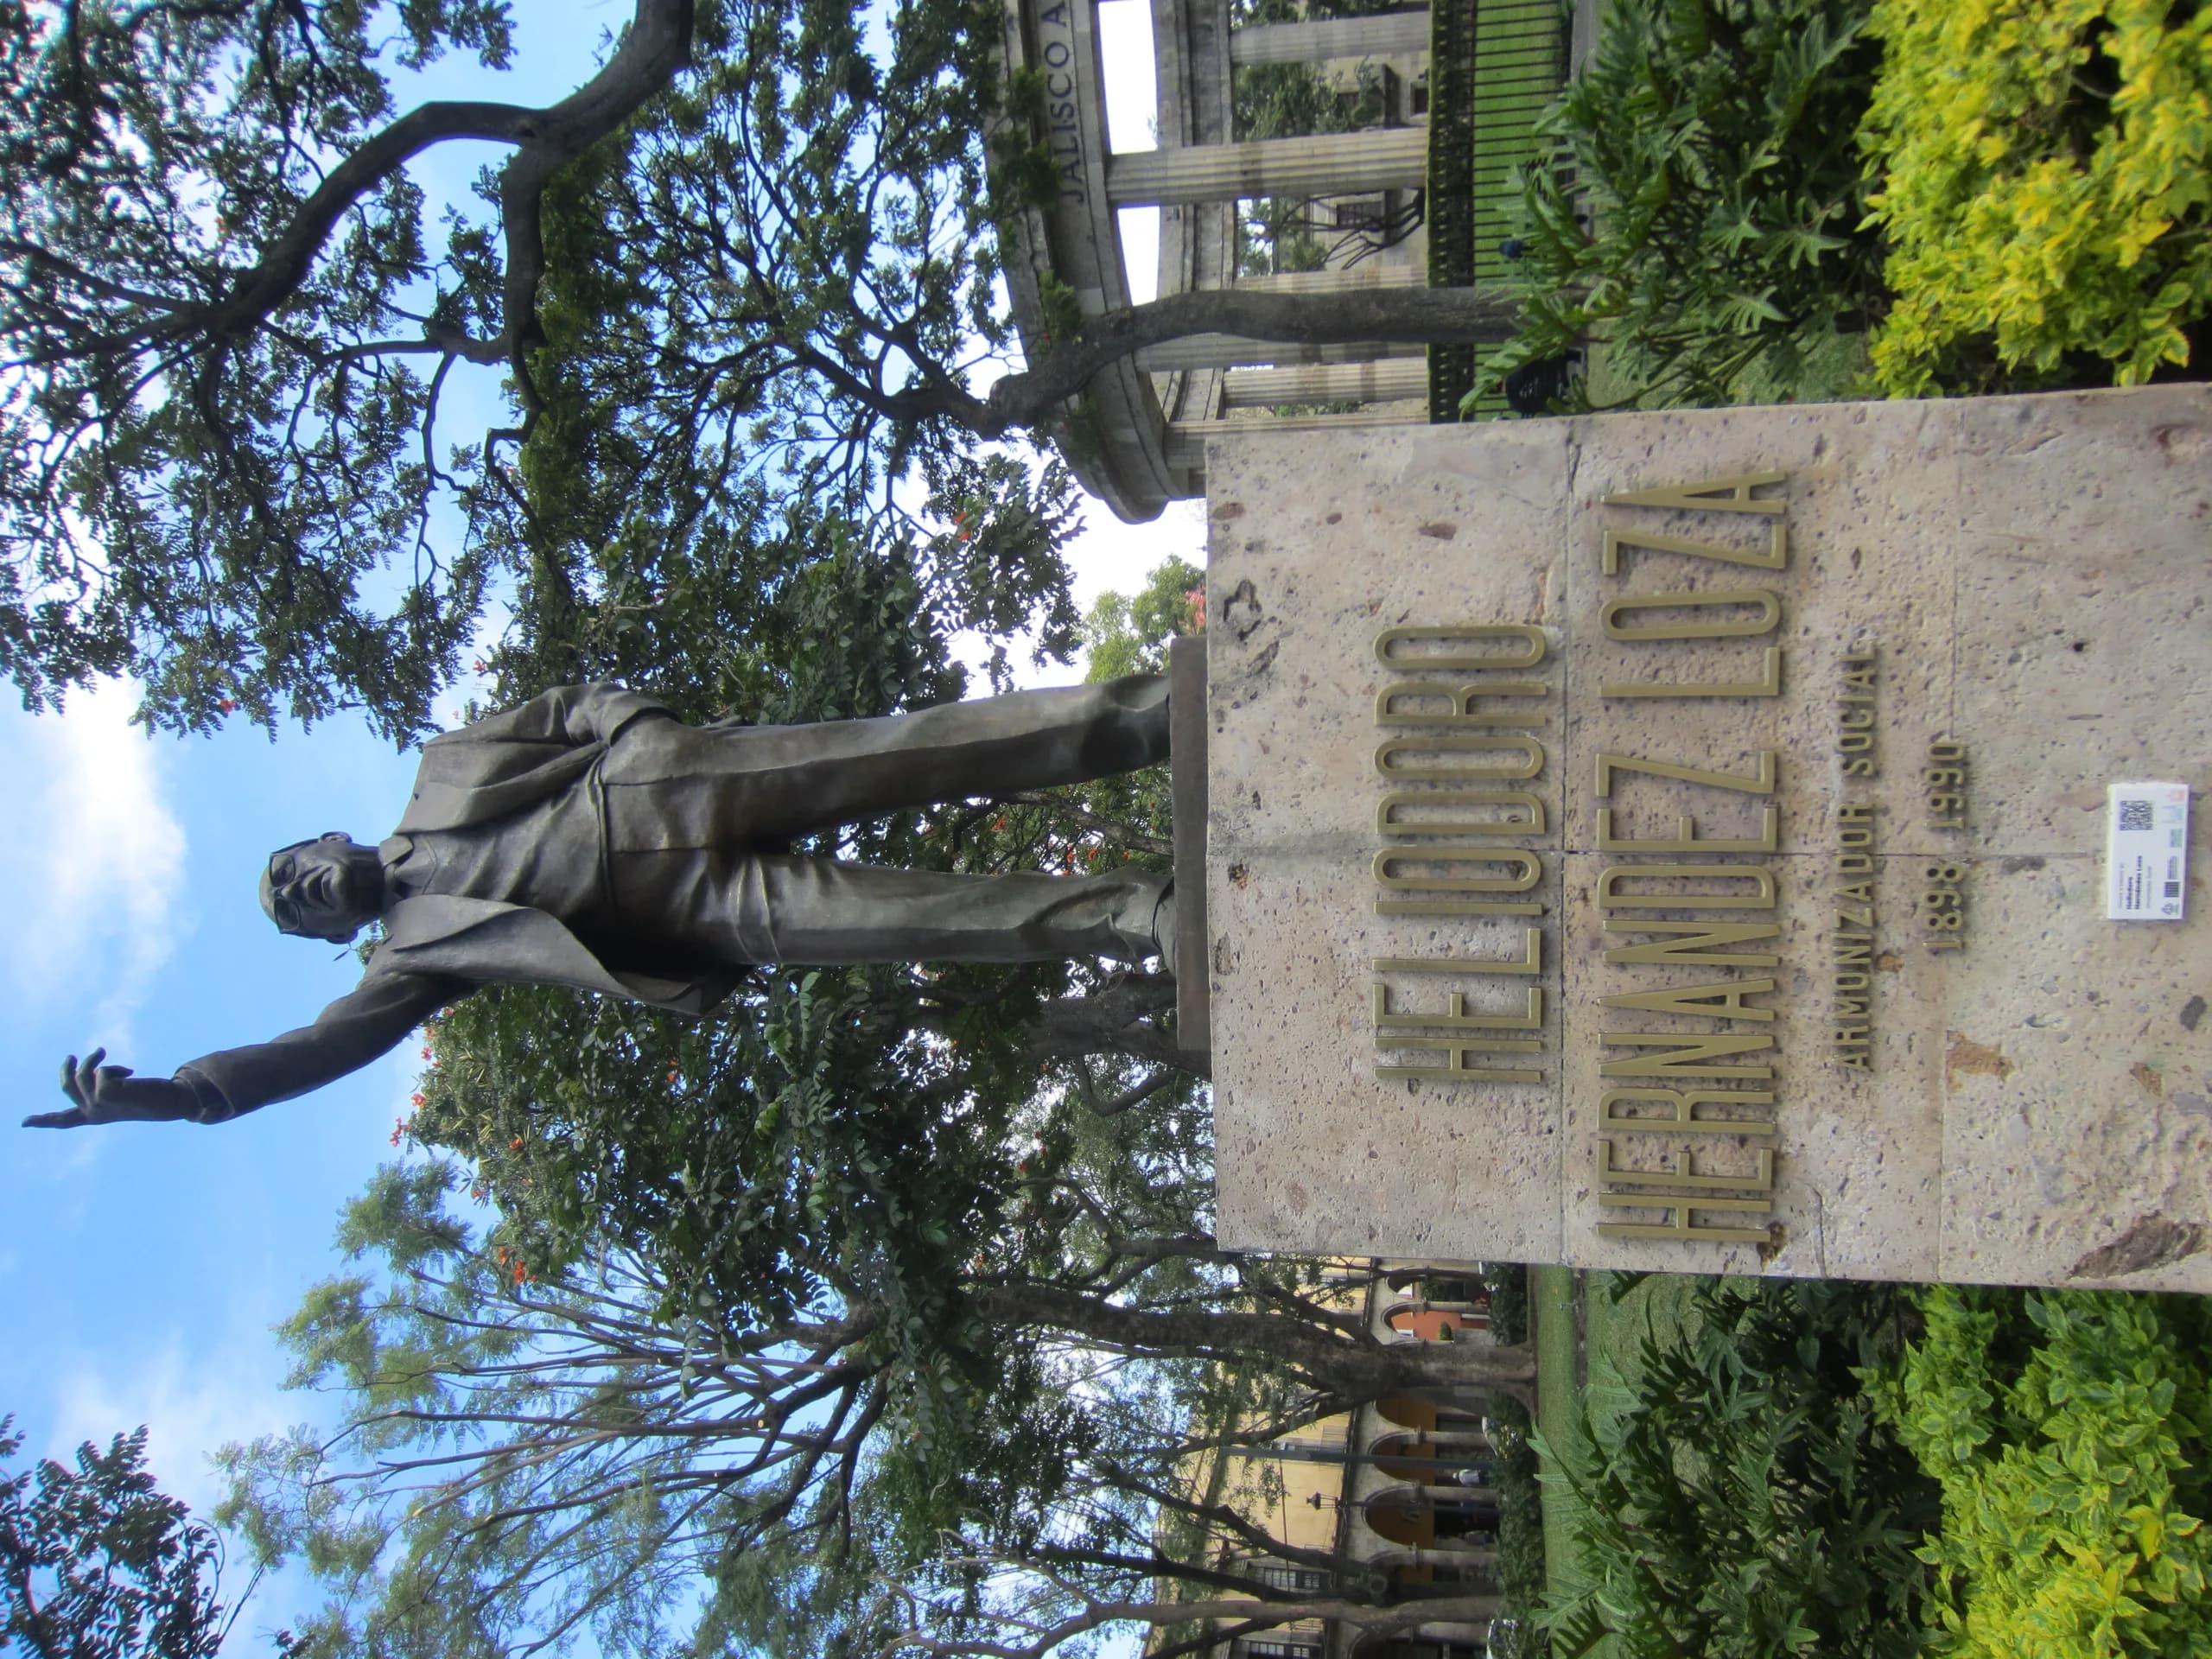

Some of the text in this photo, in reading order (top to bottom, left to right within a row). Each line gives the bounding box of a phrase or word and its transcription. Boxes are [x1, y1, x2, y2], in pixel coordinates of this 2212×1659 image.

[1044, 41, 1084, 206] JALISCO
[1371, 622, 1547, 1085] HELIODORO
[1596, 470, 1788, 1243] HERNANDEZ LOZA
[1830, 641, 1877, 1072] ARMONIZADOR SOCIAL
[1922, 740, 1965, 951] 1898 1990
